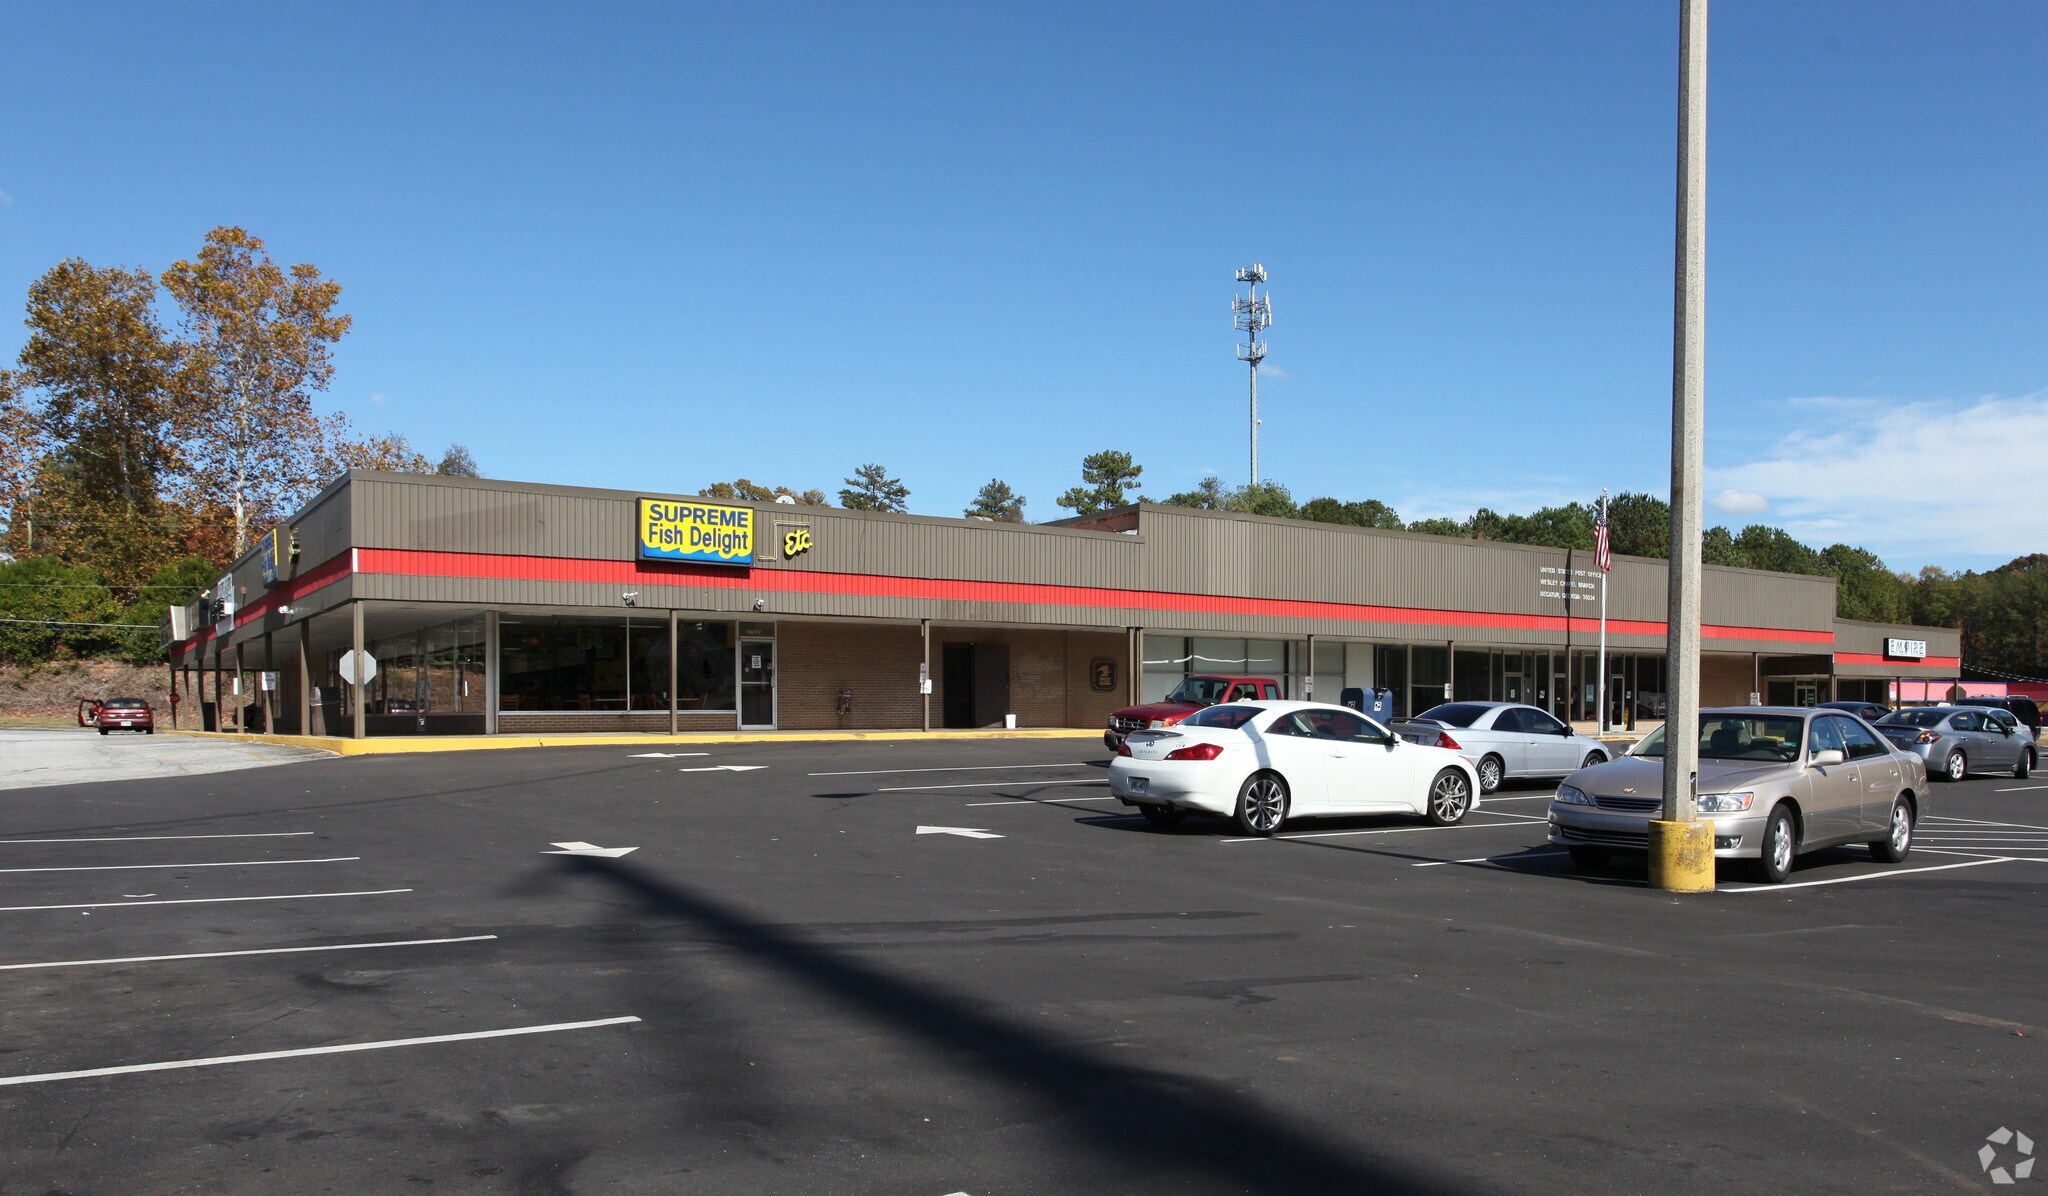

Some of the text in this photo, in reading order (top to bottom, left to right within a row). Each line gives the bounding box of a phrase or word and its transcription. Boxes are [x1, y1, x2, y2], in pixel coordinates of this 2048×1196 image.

[649, 503, 748, 528] SUPREME
[649, 522, 748, 555] Fish Delight
[1557, 568, 1573, 576] STATES
[1587, 571, 1602, 579] OFFICE
[1890, 640, 1924, 655] EMPIRE
